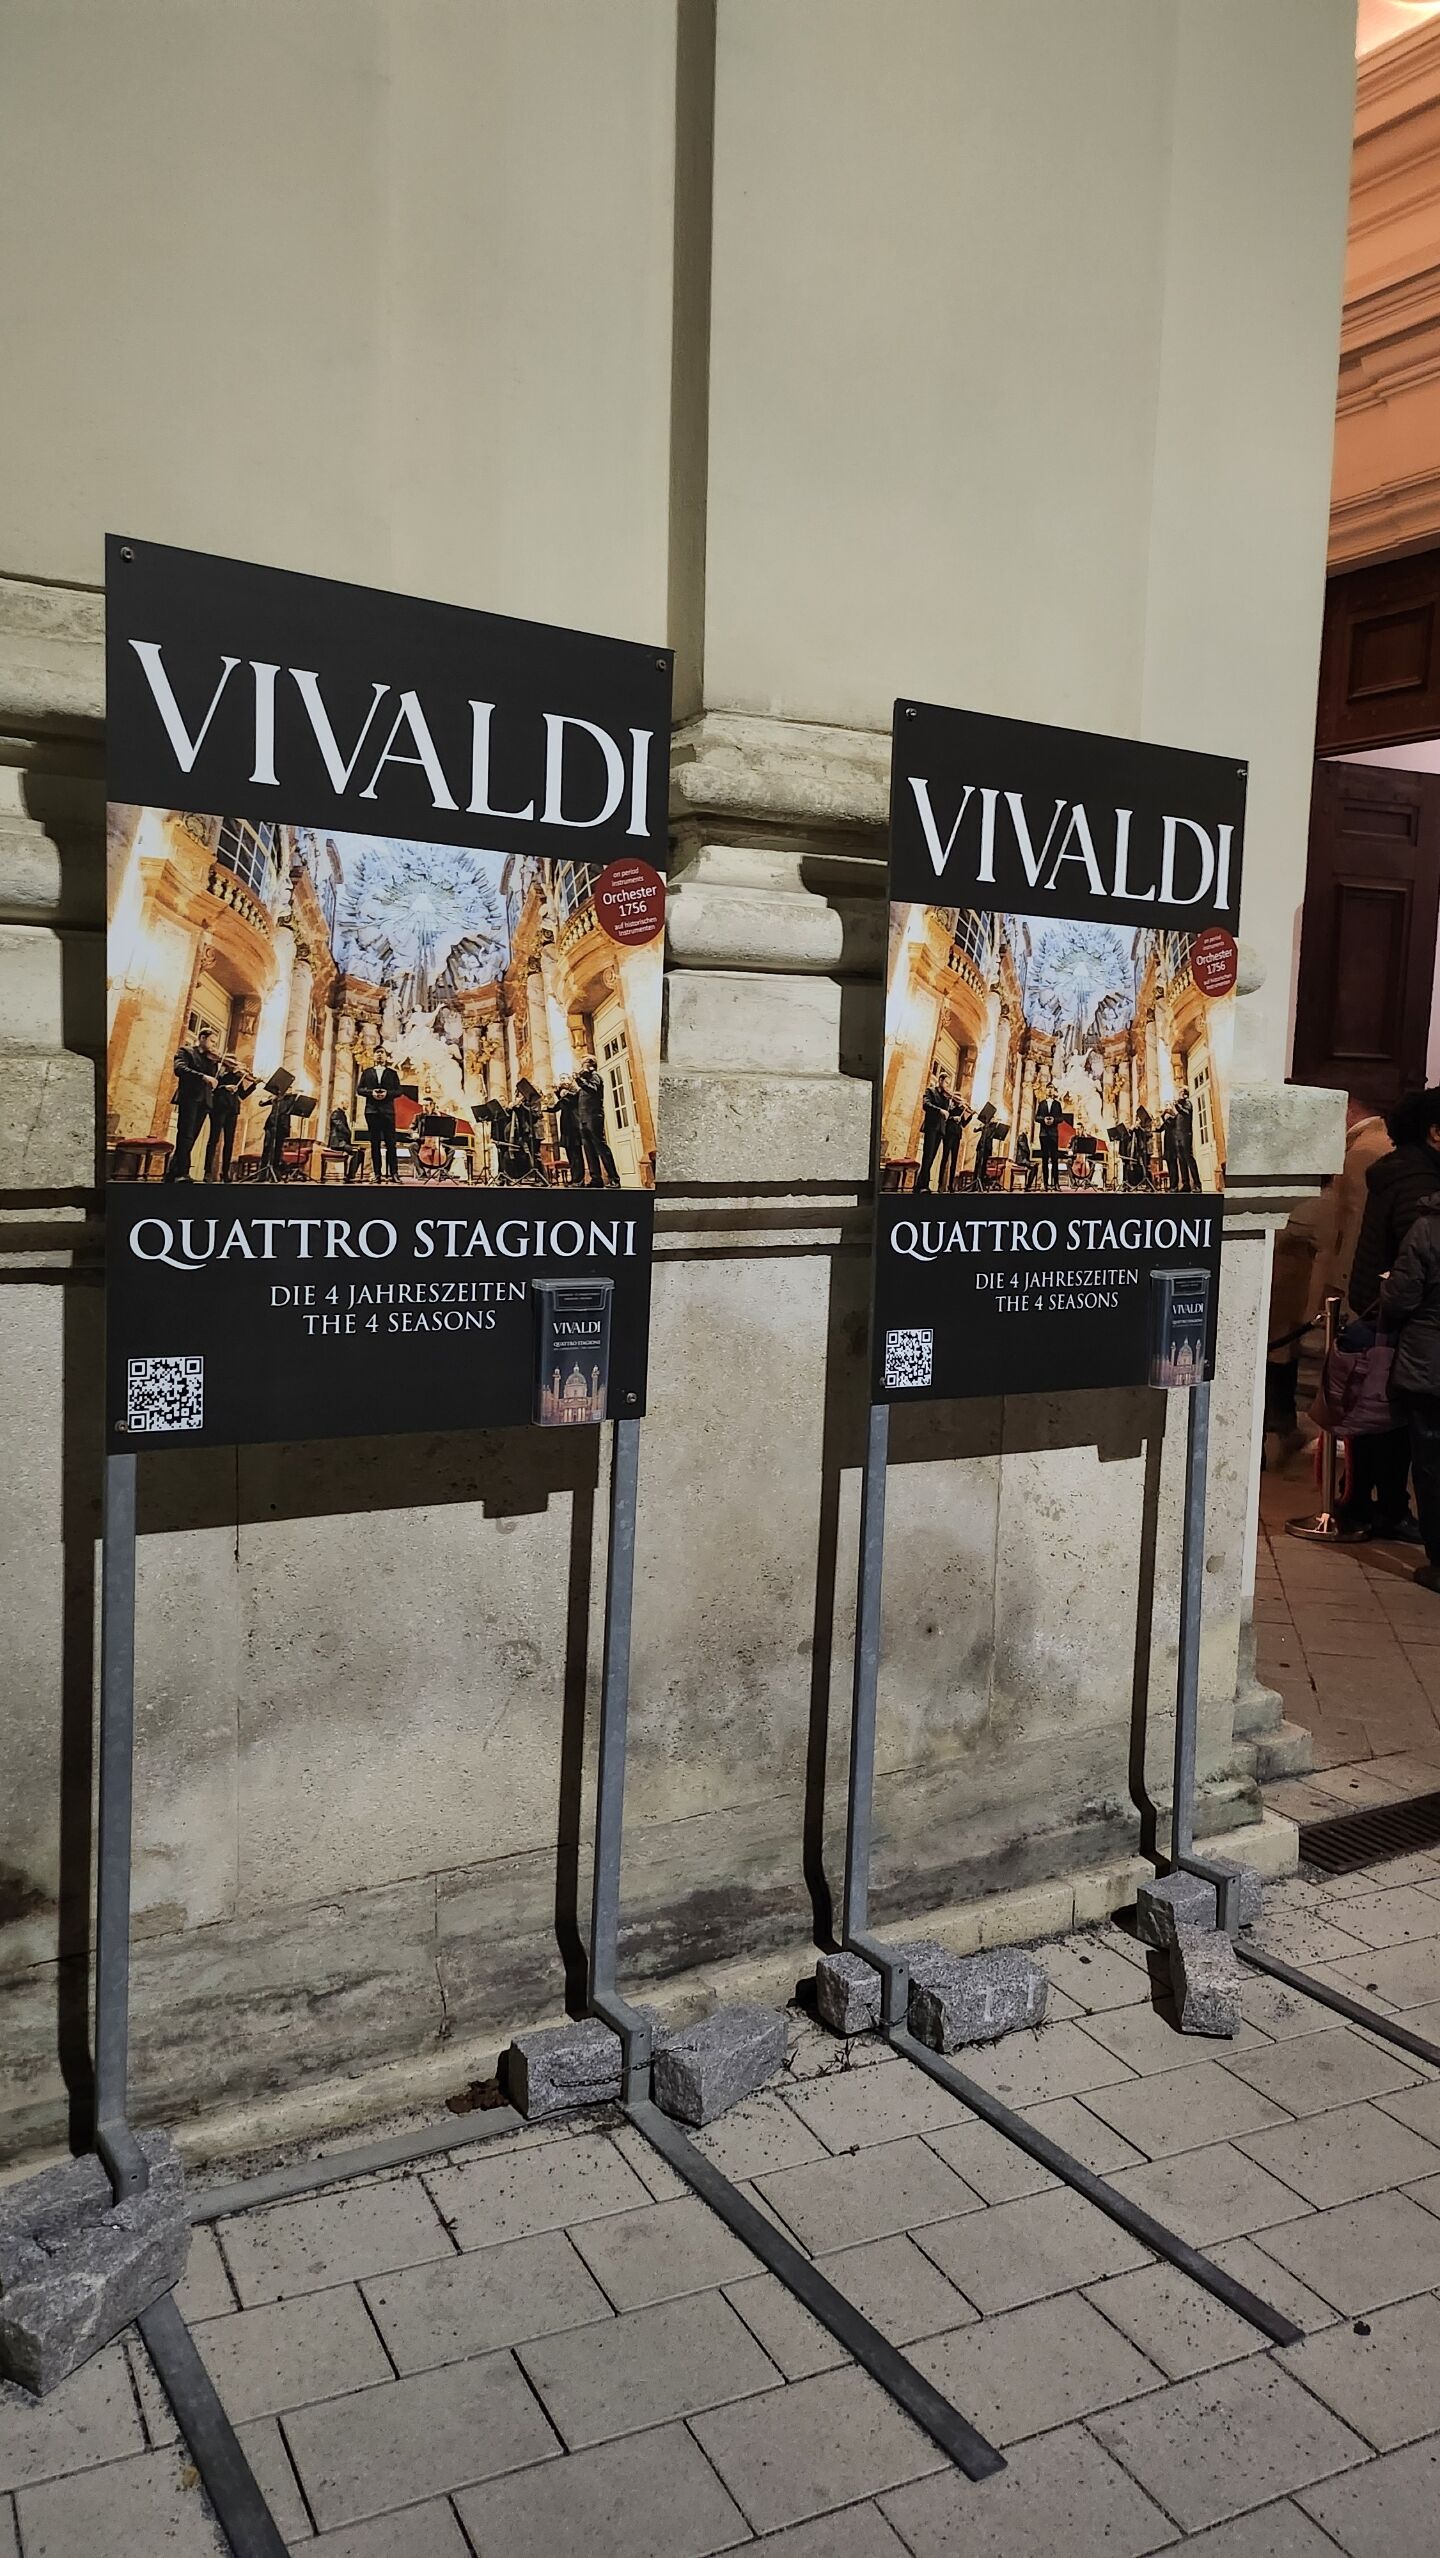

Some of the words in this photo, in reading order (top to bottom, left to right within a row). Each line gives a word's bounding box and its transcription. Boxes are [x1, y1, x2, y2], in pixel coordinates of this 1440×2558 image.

[128, 638, 655, 838] VIVALDI
[907, 776, 1235, 911] VIVALDI
[602, 886, 657, 905] Orchester
[618, 901, 647, 916] 1756
[1196, 949, 1232, 966] Orchester
[1207, 961, 1225, 974] 1756
[128, 1218, 398, 1270] QUATTRO
[412, 1219, 637, 1258] STAGIONI
[890, 1219, 1057, 1262] QUATTRO
[1066, 1218, 1213, 1251] STAGIONI
[975, 1272, 1006, 1290] DIE
[1009, 1272, 1020, 1289] 4
[1023, 1268, 1140, 1293] JAHRESZEITEN
[270, 1284, 316, 1307] DIE
[324, 1284, 339, 1305] 4
[347, 1281, 527, 1310] JAHRESZEITEN
[995, 1295, 1030, 1313] THE
[1034, 1295, 1044, 1311] 4
[1048, 1291, 1120, 1311] SEASONS
[1172, 1303, 1204, 1314] VIVALDI
[302, 1314, 357, 1336] THE
[365, 1313, 379, 1333] 4
[387, 1309, 497, 1333] SEASONS
[553, 1321, 600, 1334] VIVALDI
